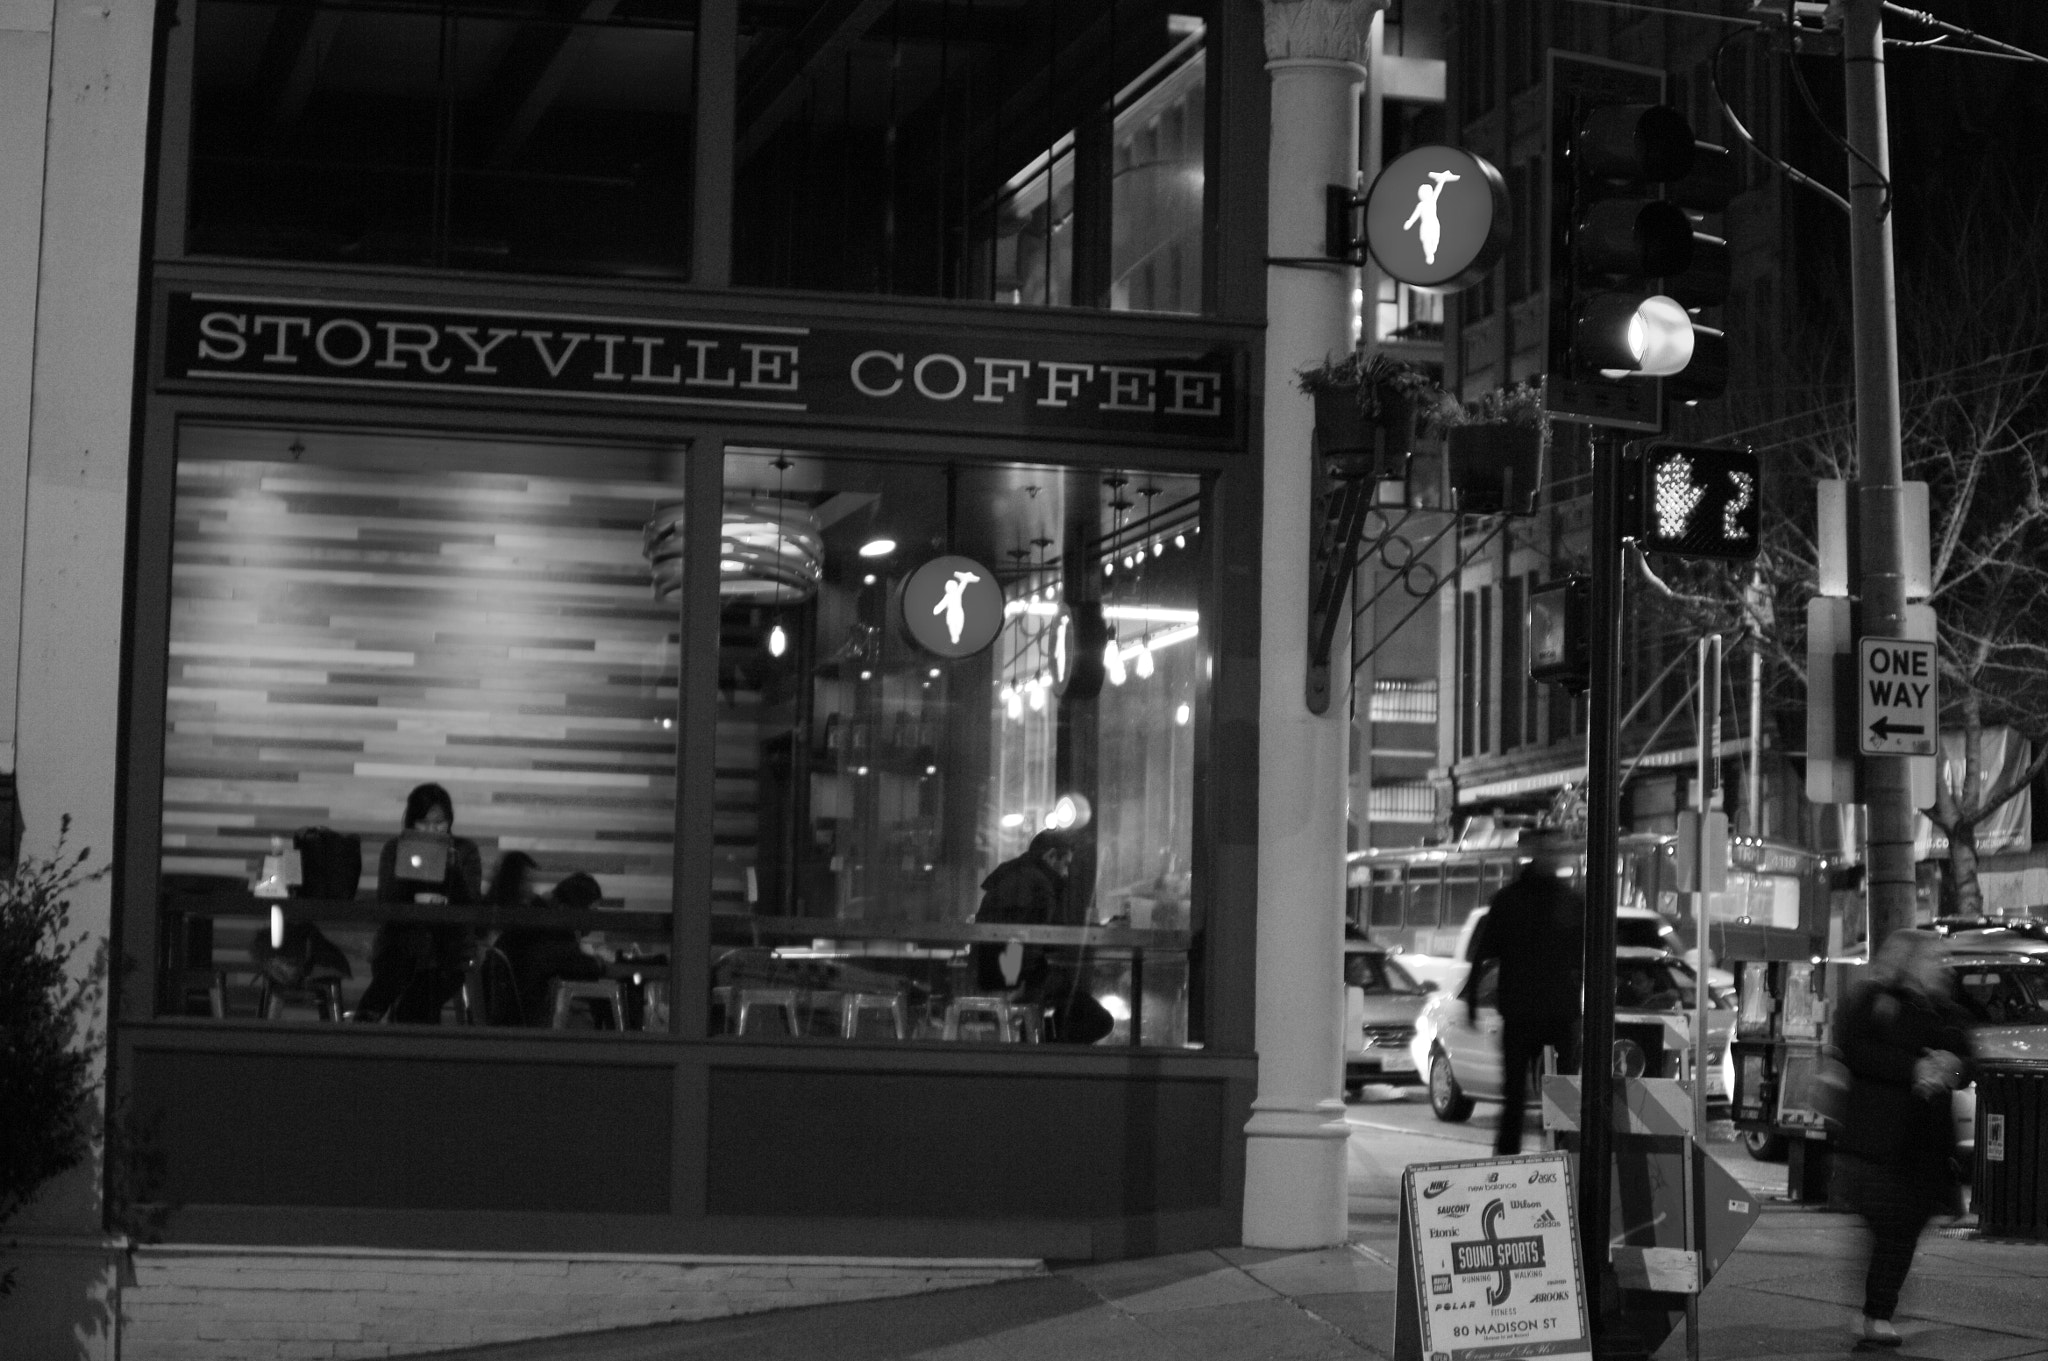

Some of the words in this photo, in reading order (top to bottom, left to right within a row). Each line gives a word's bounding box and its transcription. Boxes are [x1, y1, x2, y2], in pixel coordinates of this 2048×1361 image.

[198, 311, 799, 391] STORYVILLE
[850, 349, 1221, 417] COFFEE
[1723, 470, 1752, 539] 2
[1869, 647, 1928, 677] ONE
[1869, 680, 1931, 708] WAY
[1429, 1180, 1450, 1191] NIKE
[1484, 1182, 1518, 1191] balance
[1437, 1204, 1470, 1215] SAUCONY
[1510, 1200, 1542, 1209] Wilson
[1533, 1220, 1561, 1229] adidas
[1429, 1226, 1460, 1239] Etonic
[1458, 1244, 1494, 1269] SOUND
[1497, 1240, 1539, 1266] SPORTS
[1461, 1274, 1492, 1284] RUNNING
[1514, 1270, 1543, 1279] WALKING
[1539, 1290, 1570, 1302] BROOKS
[1435, 1301, 1476, 1312] POLAR
[1491, 1307, 1517, 1317] FITNESS
[1453, 1325, 1470, 1338] 80
[1474, 1321, 1538, 1336] MADISON
[1543, 1317, 1558, 1329] ST
